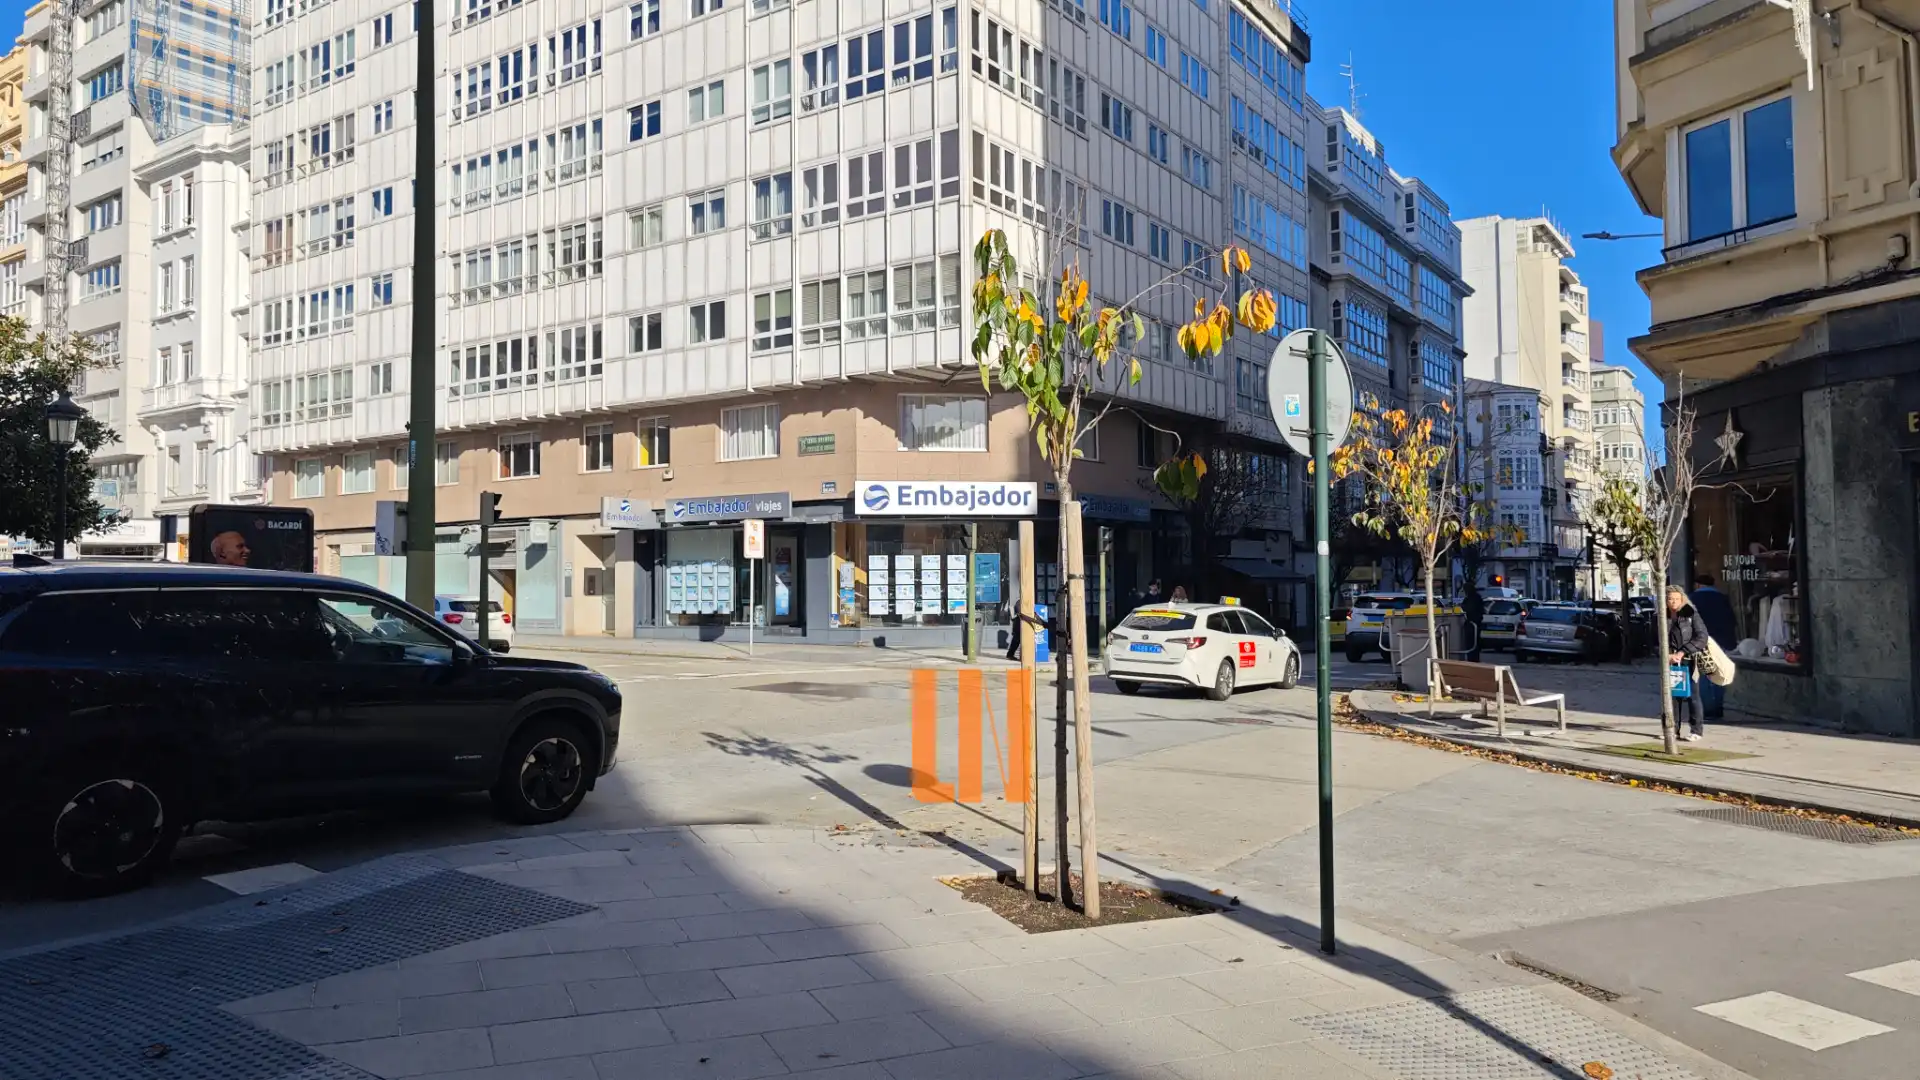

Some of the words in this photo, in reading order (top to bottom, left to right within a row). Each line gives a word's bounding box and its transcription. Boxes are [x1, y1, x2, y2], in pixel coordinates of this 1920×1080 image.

[897, 484, 1032, 511] Embajador
[688, 500, 751, 517] Embajador
[755, 500, 783, 513] viajes
[267, 519, 302, 530] BACARDÍ
[1723, 555, 1733, 567] BE
[1735, 555, 1756, 566] YOUR
[1721, 570, 1741, 582] TRUE
[1743, 569, 1759, 581] SELF
